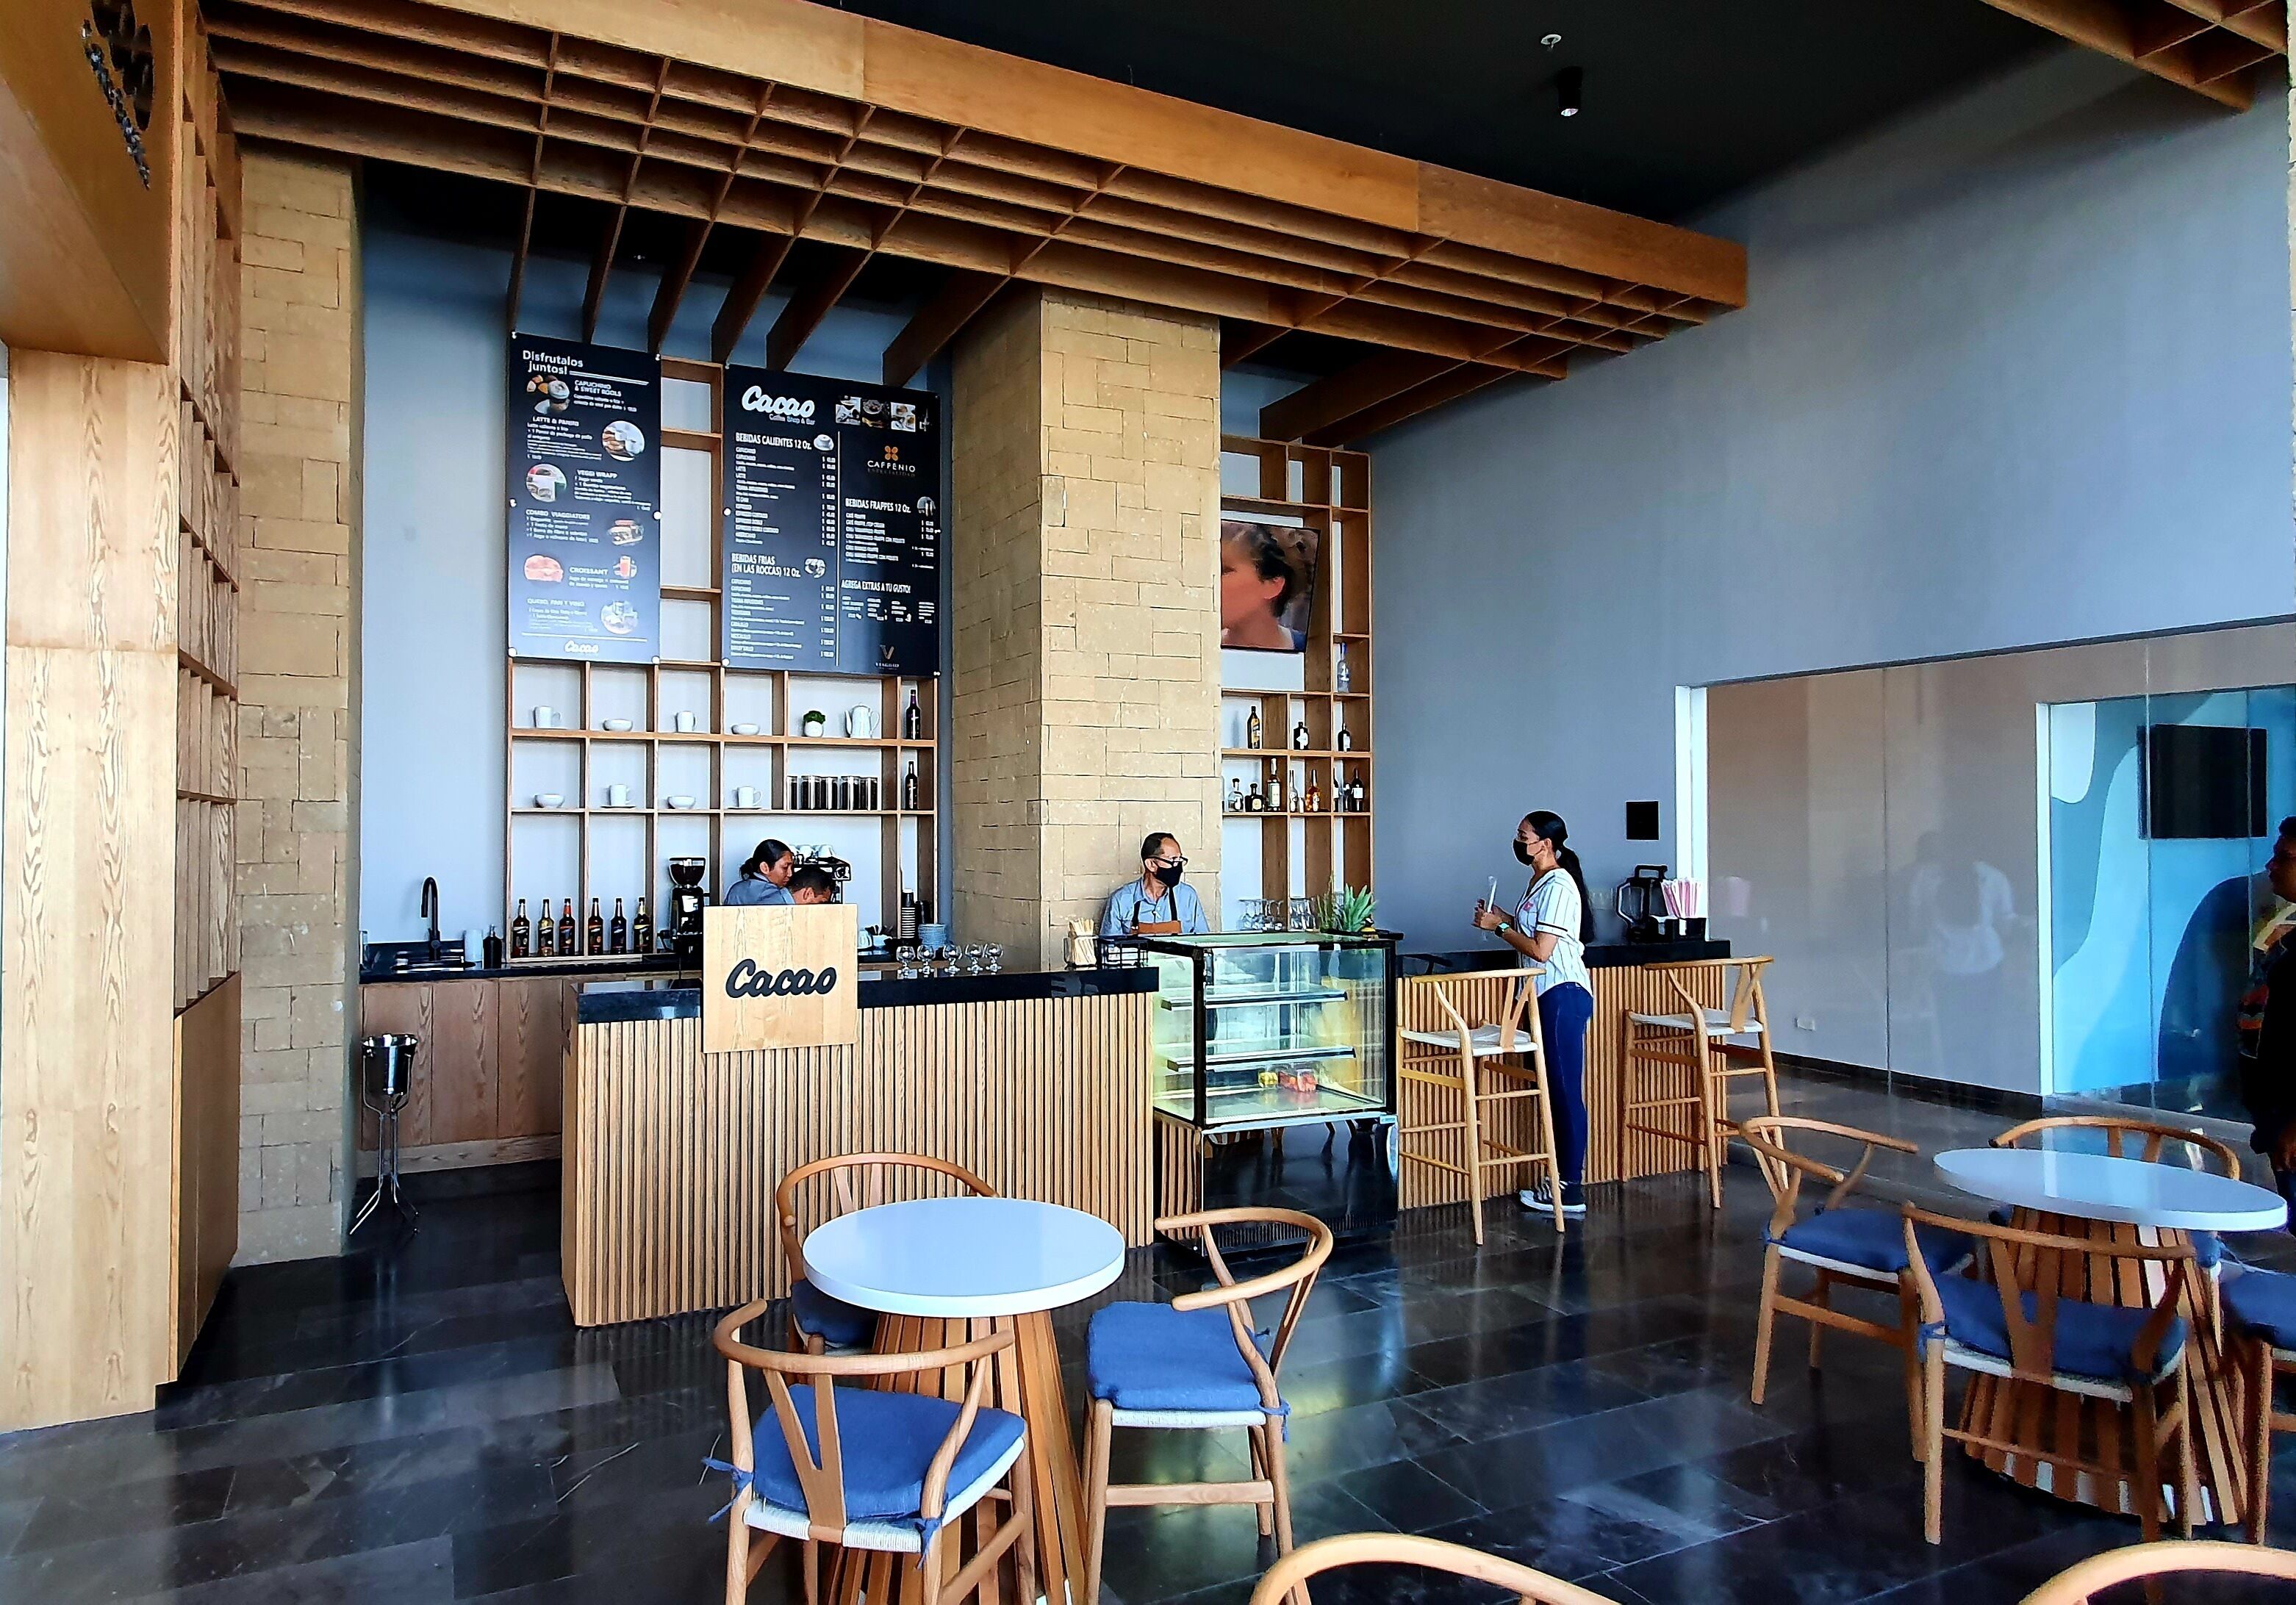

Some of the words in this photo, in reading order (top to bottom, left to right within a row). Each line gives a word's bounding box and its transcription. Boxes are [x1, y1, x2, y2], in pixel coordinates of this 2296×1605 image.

[523, 350, 583, 367] Disfrutalos
[742, 385, 815, 418] Cacao
[736, 432, 761, 445] BEBIDAS
[761, 435, 793, 448] CALIENTES
[794, 439, 802, 448] 12
[845, 498, 869, 509] BEBIDAS
[895, 503, 901, 513] 12
[731, 553, 757, 564] BEBIDAS
[758, 555, 775, 566] FRIAS
[731, 564, 742, 573] (EN
[744, 564, 755, 574] LAS
[756, 565, 781, 577] ROCCAS)
[783, 567, 791, 577] 12
[841, 580, 861, 589] AGREGA
[862, 581, 880, 592] EXTRAS
[881, 583, 885, 592] A
[886, 584, 892, 592] TU
[564, 640, 599, 653] Cacao
[725, 958, 837, 999] Cacao
